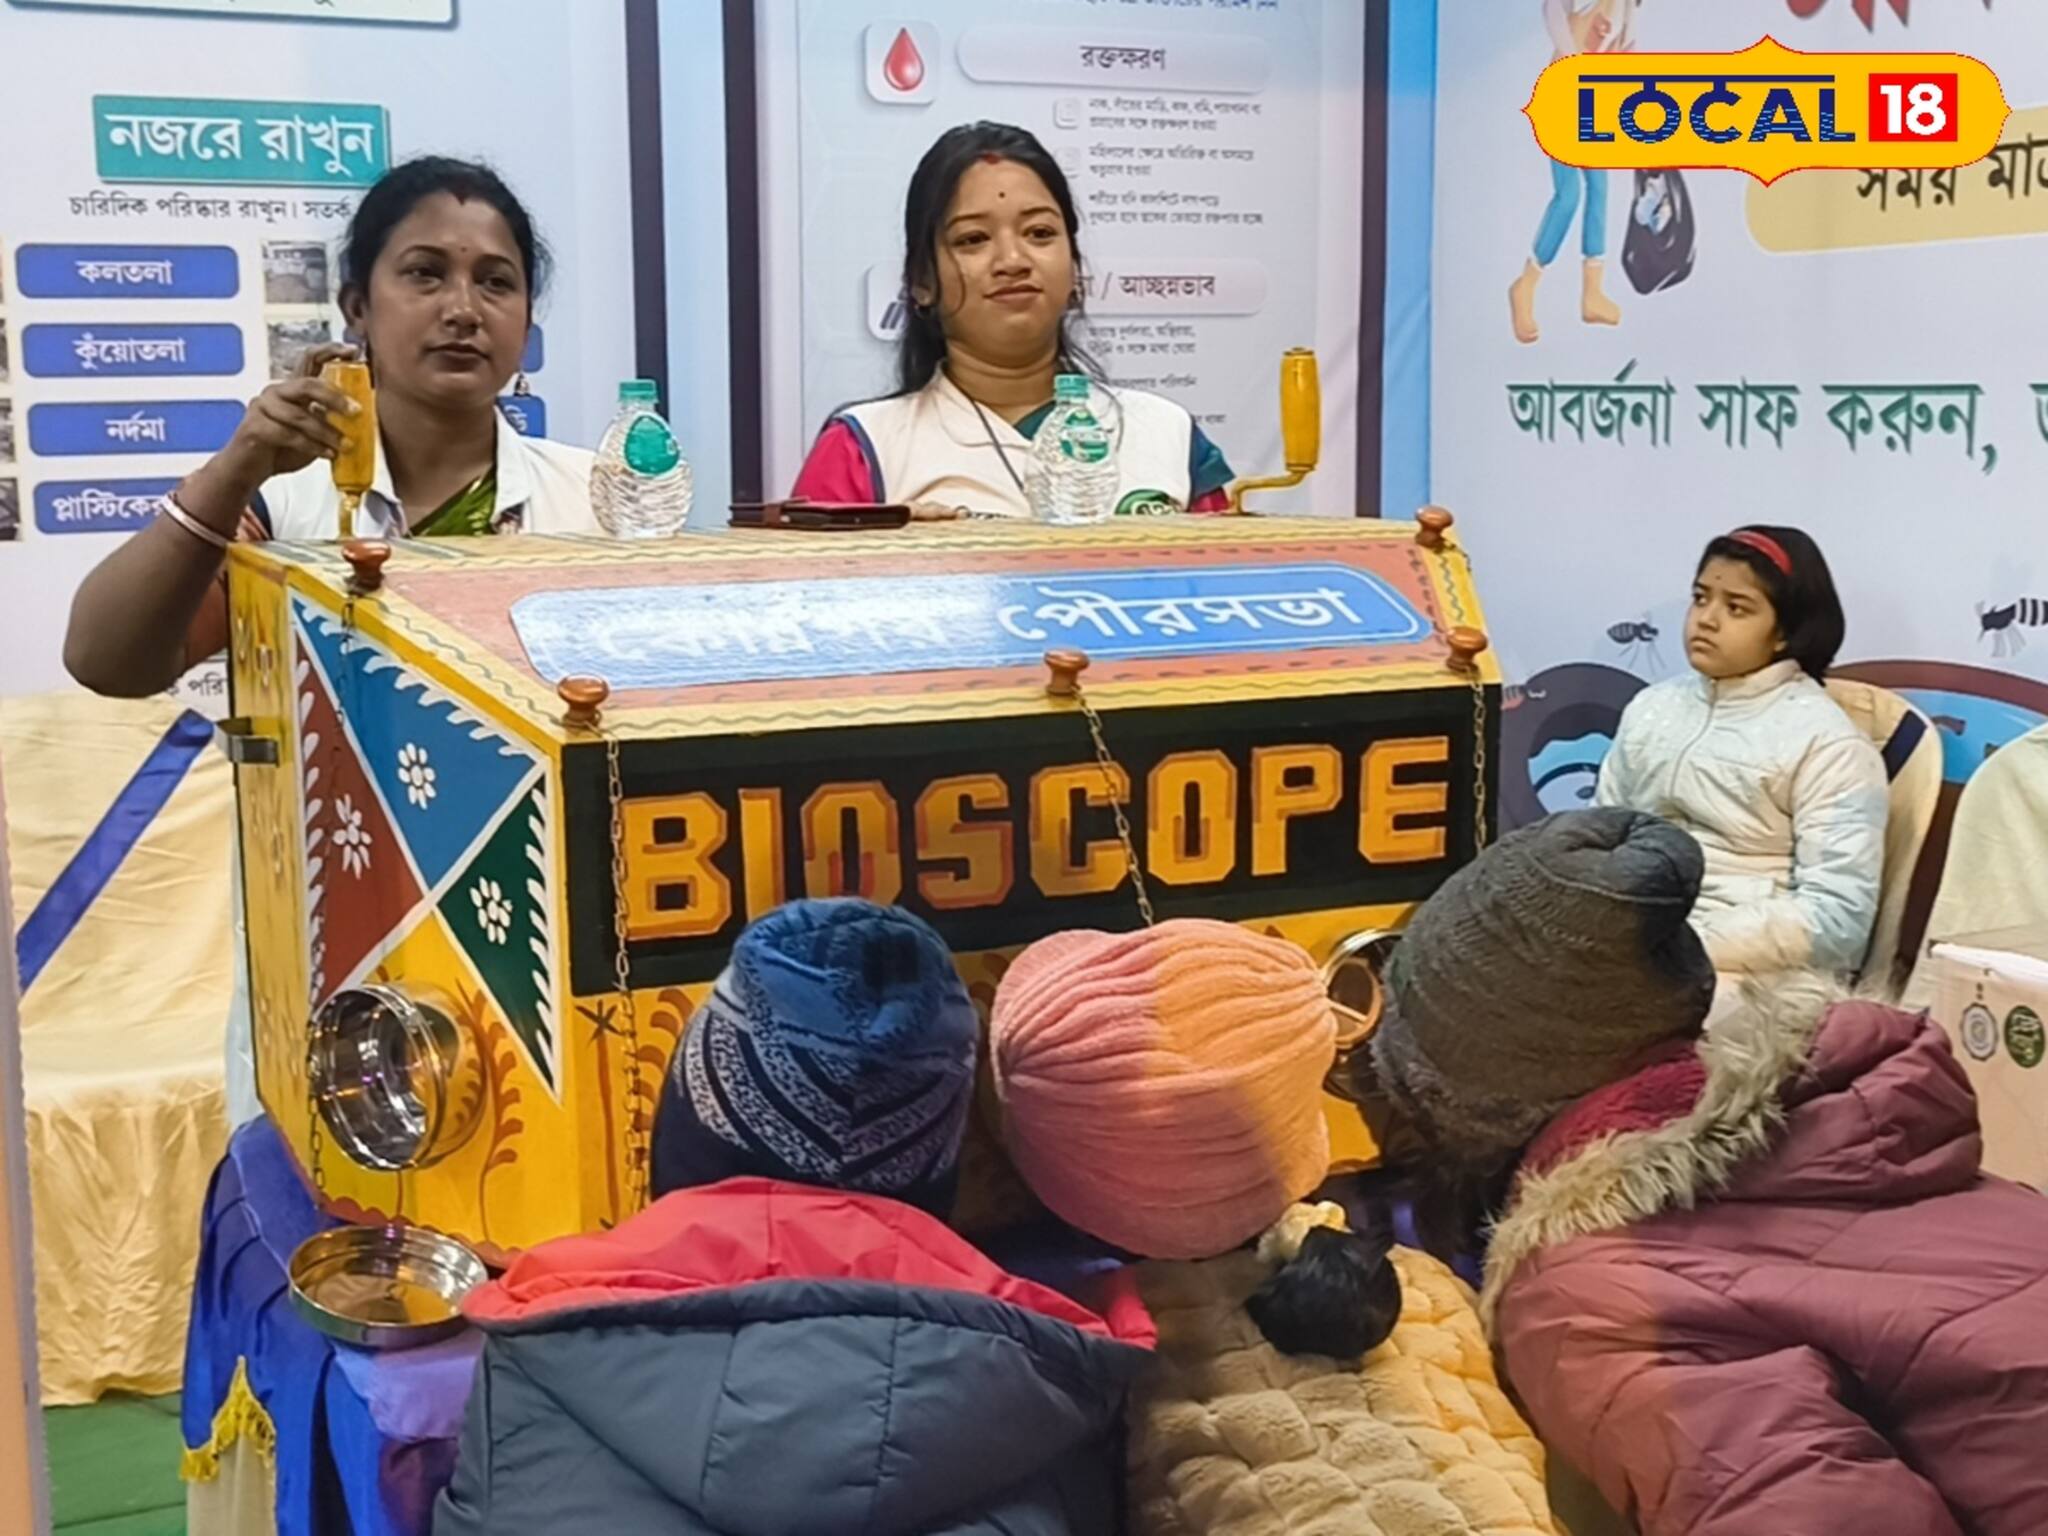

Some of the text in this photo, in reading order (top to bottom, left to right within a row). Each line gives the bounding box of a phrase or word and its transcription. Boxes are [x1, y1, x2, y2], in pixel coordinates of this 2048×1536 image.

[104, 114, 375, 177] নজরে রাখুন
[1987, 132, 2048, 200] মা
[69, 189, 148, 218] চারিদিক
[77, 259, 173, 286] কলতলা
[73, 333, 187, 370] কুঁয়োতলা
[104, 409, 168, 443] নর্দমা
[1506, 358, 1675, 449] আবর্জনা
[1695, 376, 1800, 450] সাফ
[1821, 384, 1997, 475] করুন,
[999, 586, 1363, 640] পৌরসভা
[621, 735, 1450, 941] BIOSCOPE
